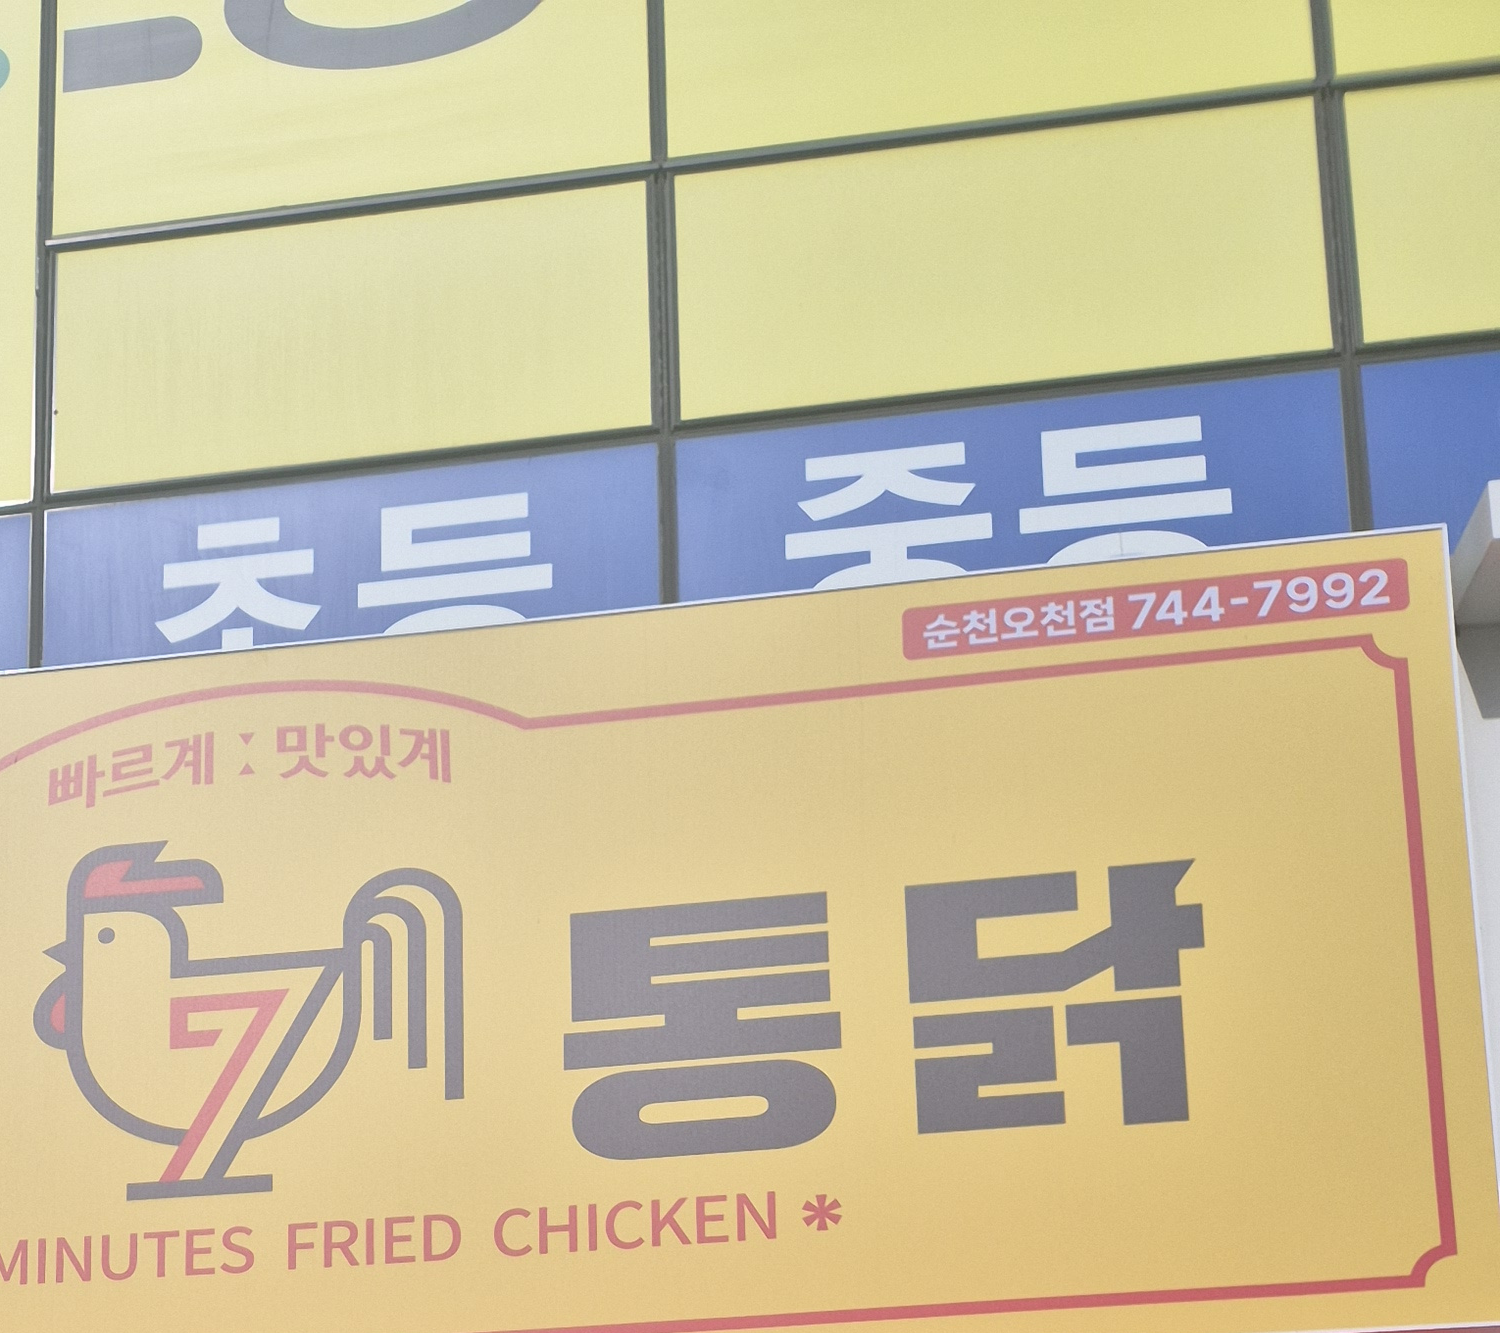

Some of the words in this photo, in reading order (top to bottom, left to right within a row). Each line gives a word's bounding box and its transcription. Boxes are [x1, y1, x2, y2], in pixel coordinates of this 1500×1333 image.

[920, 602, 1117, 650] 순천오천점
[1128, 569, 1391, 626] 744-7992
[564, 858, 1205, 1160] 통닭
[284, 1209, 464, 1269] FRIED
[491, 1188, 783, 1258] CHICKEN
